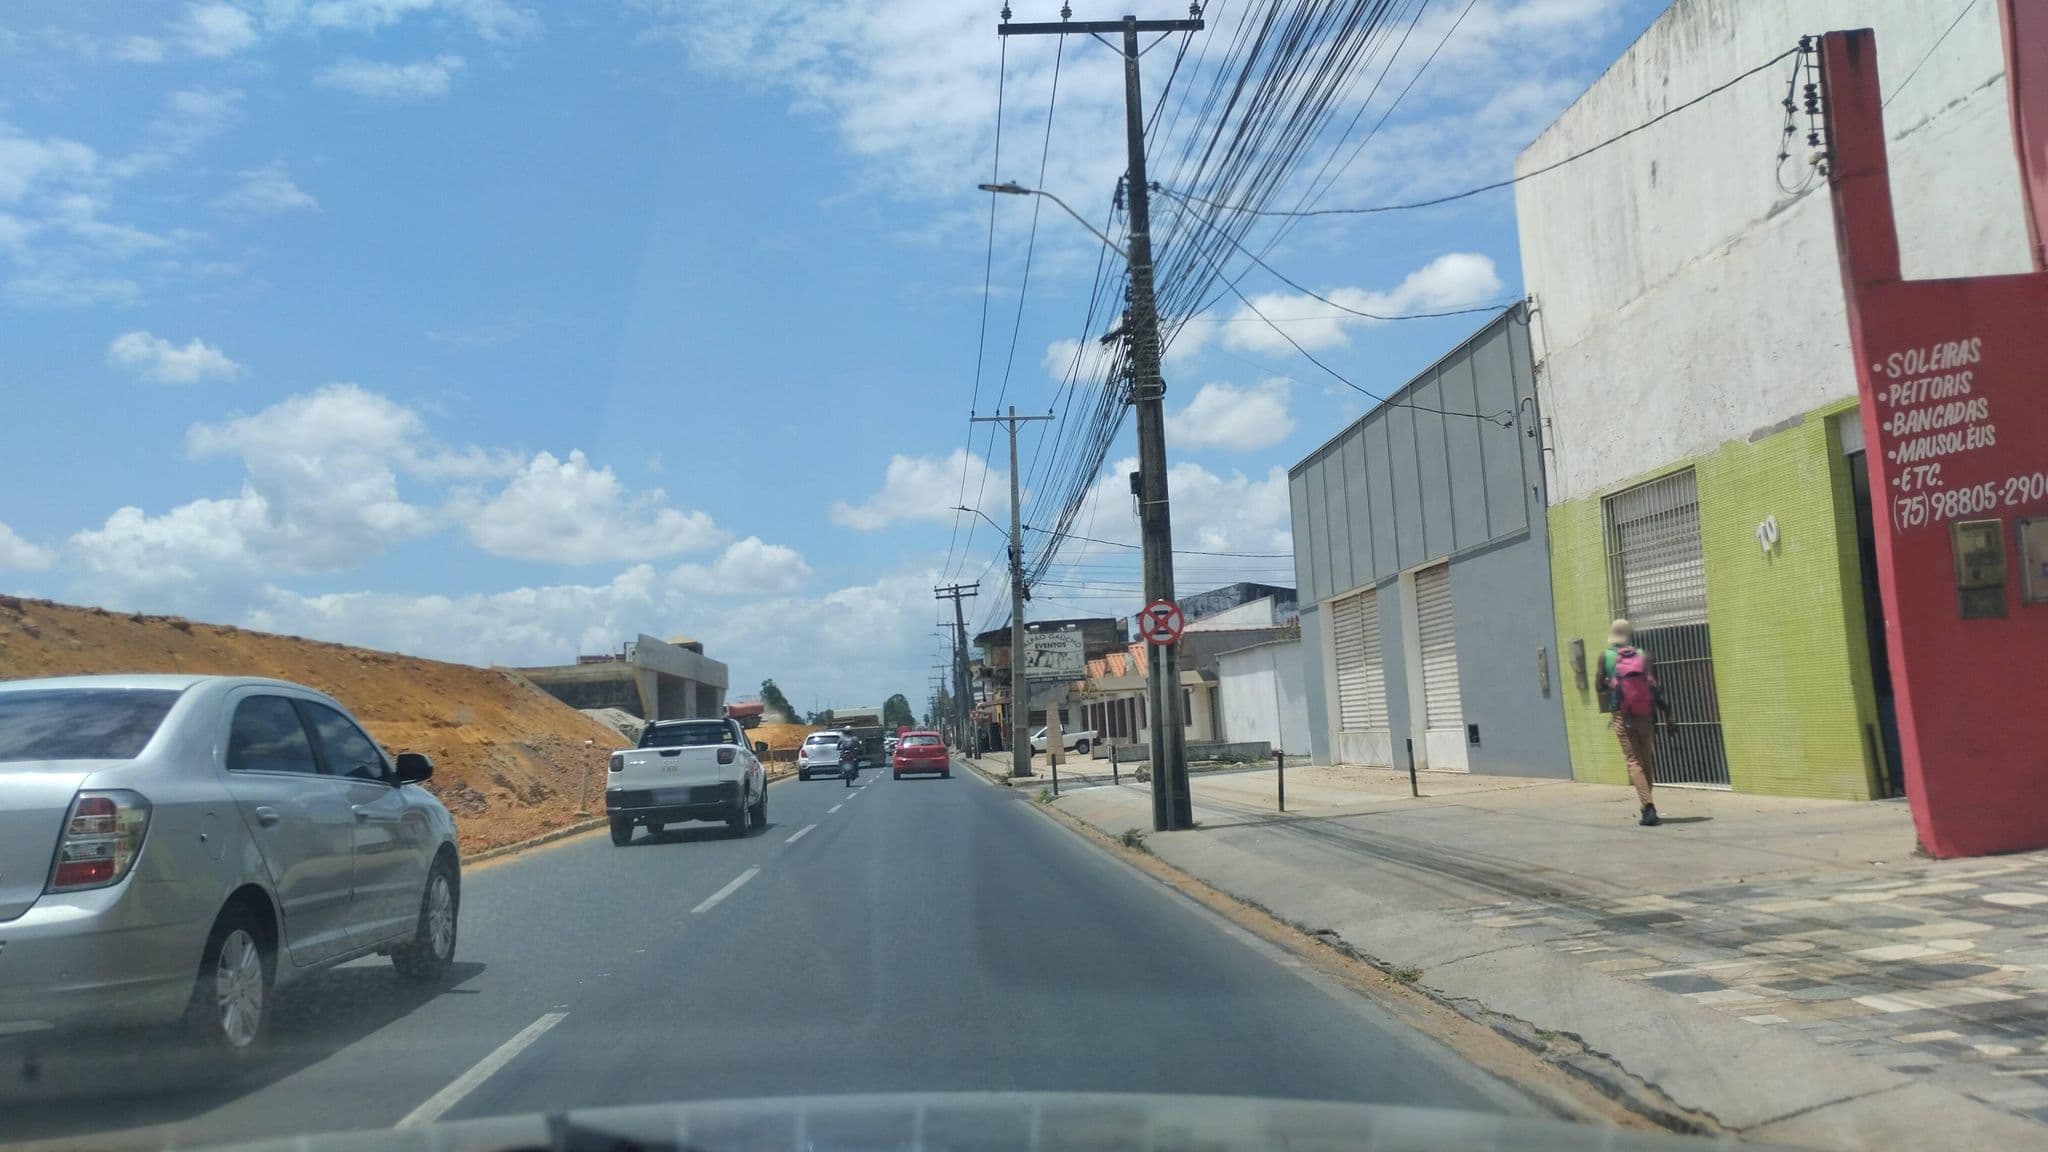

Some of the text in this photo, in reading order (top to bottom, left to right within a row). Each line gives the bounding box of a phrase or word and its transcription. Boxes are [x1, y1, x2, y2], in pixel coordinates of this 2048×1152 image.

[1886, 337, 1982, 378] SOLEIRAS
[1889, 371, 1973, 408] PEITORIS
[1892, 397, 1989, 437] BANCADAS
[1896, 424, 1996, 465] MAUSOLÉUS
[1901, 463, 1943, 492] ETC.
[1893, 471, 2048, 535] (75) 98805-290
[1024, 634, 1046, 649] ALPÃO
